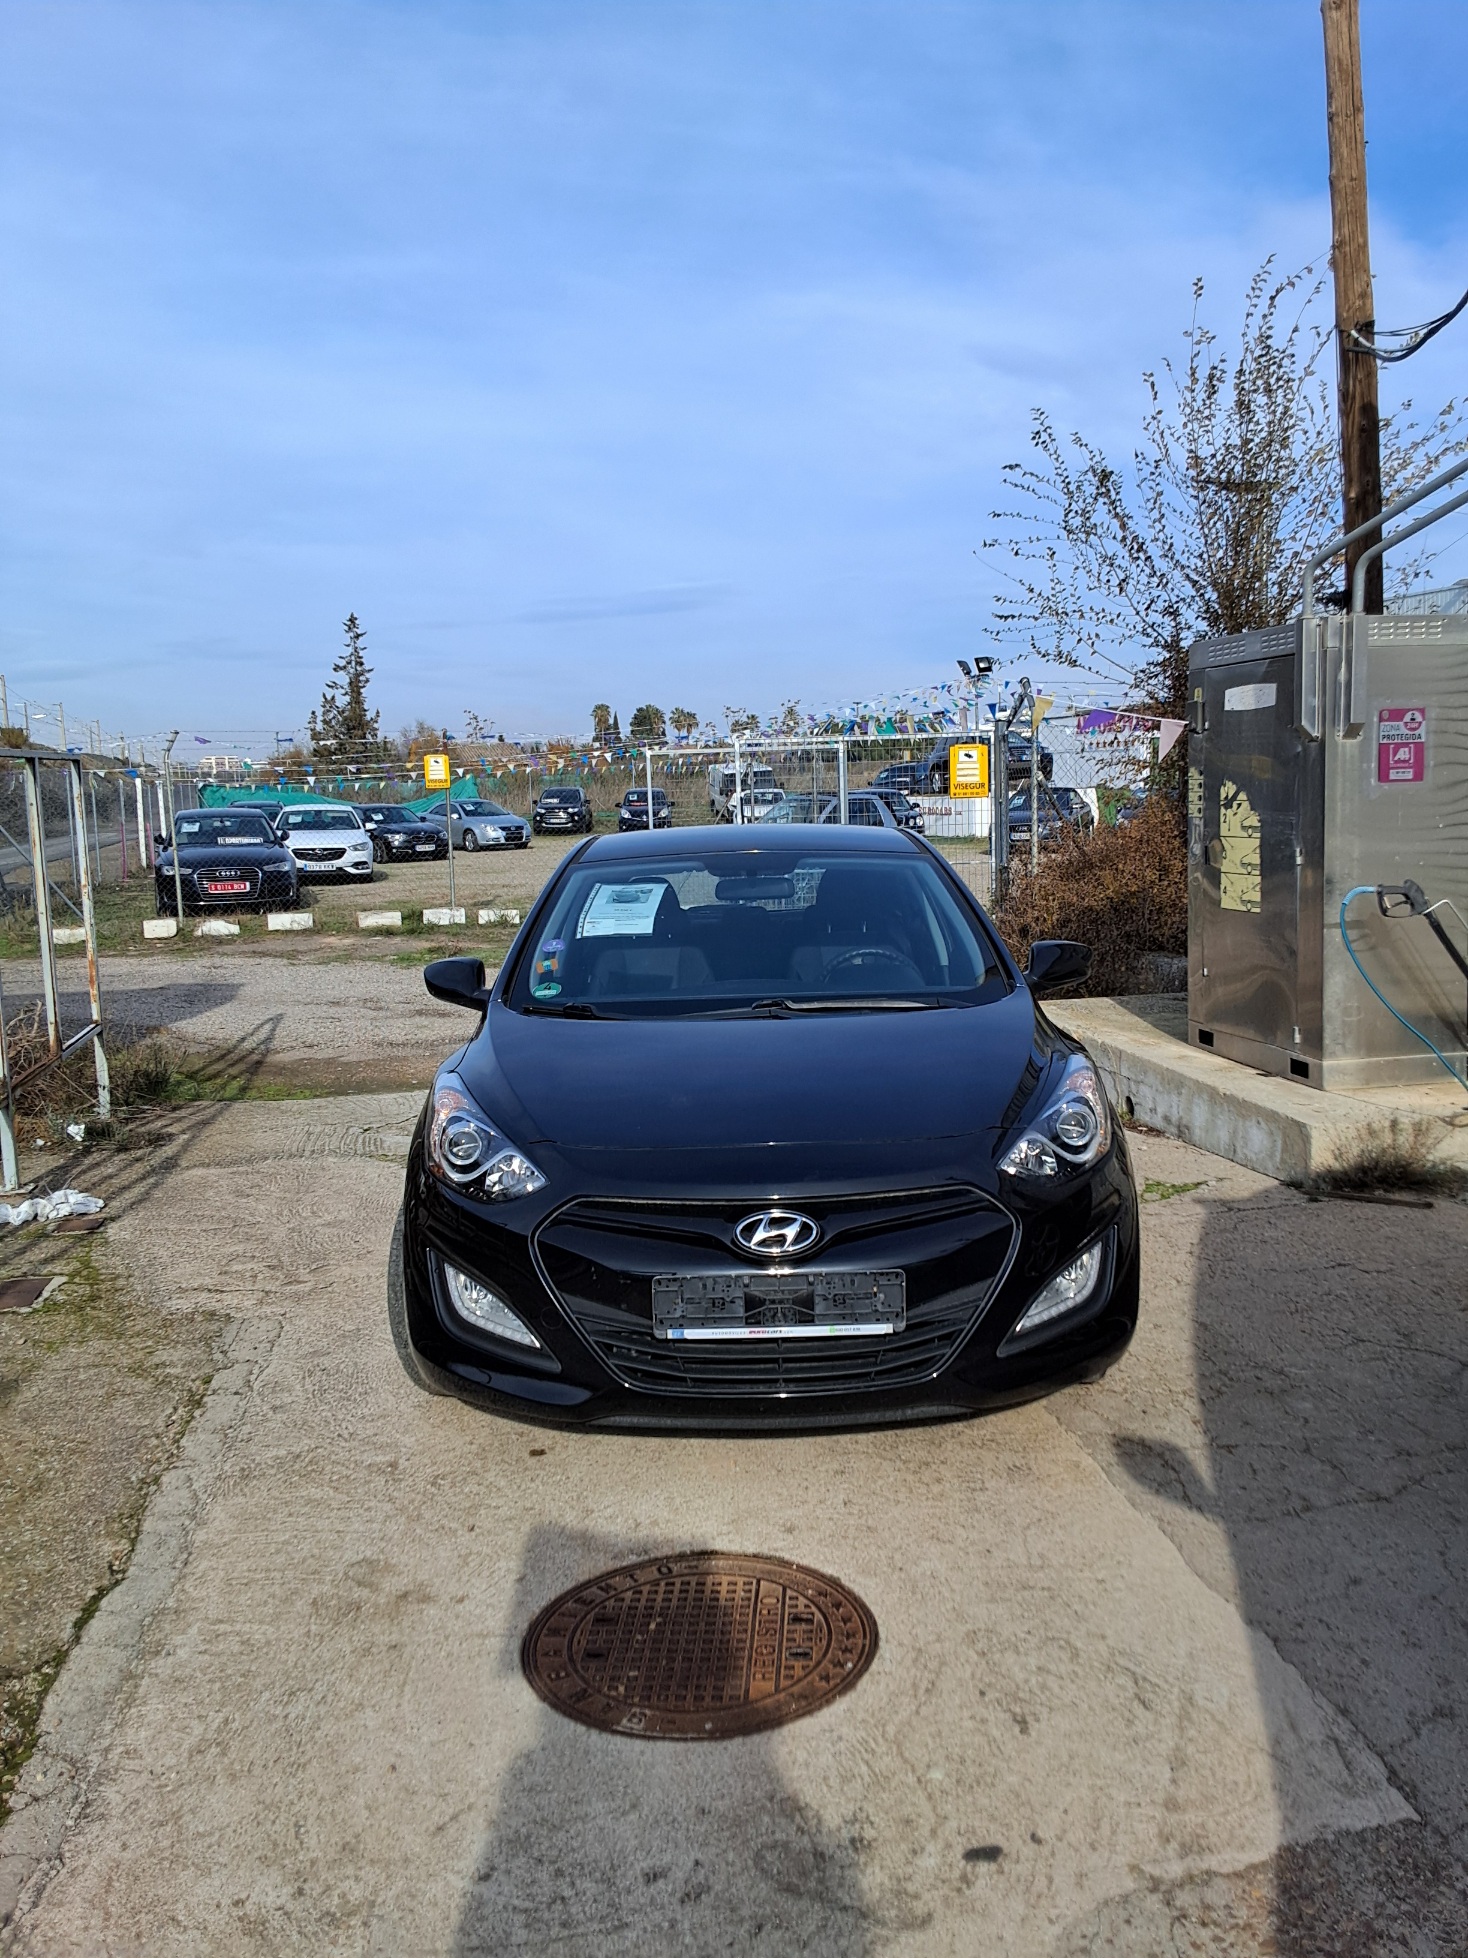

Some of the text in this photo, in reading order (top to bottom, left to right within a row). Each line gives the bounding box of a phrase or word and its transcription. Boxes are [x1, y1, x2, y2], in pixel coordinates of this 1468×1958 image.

[1381, 723, 1401, 733] ZONA
[1381, 733, 1422, 742] PROTEGIDA
[953, 782, 986, 790] VISEGUR
[753, 1594, 780, 1683] REGISTRO
